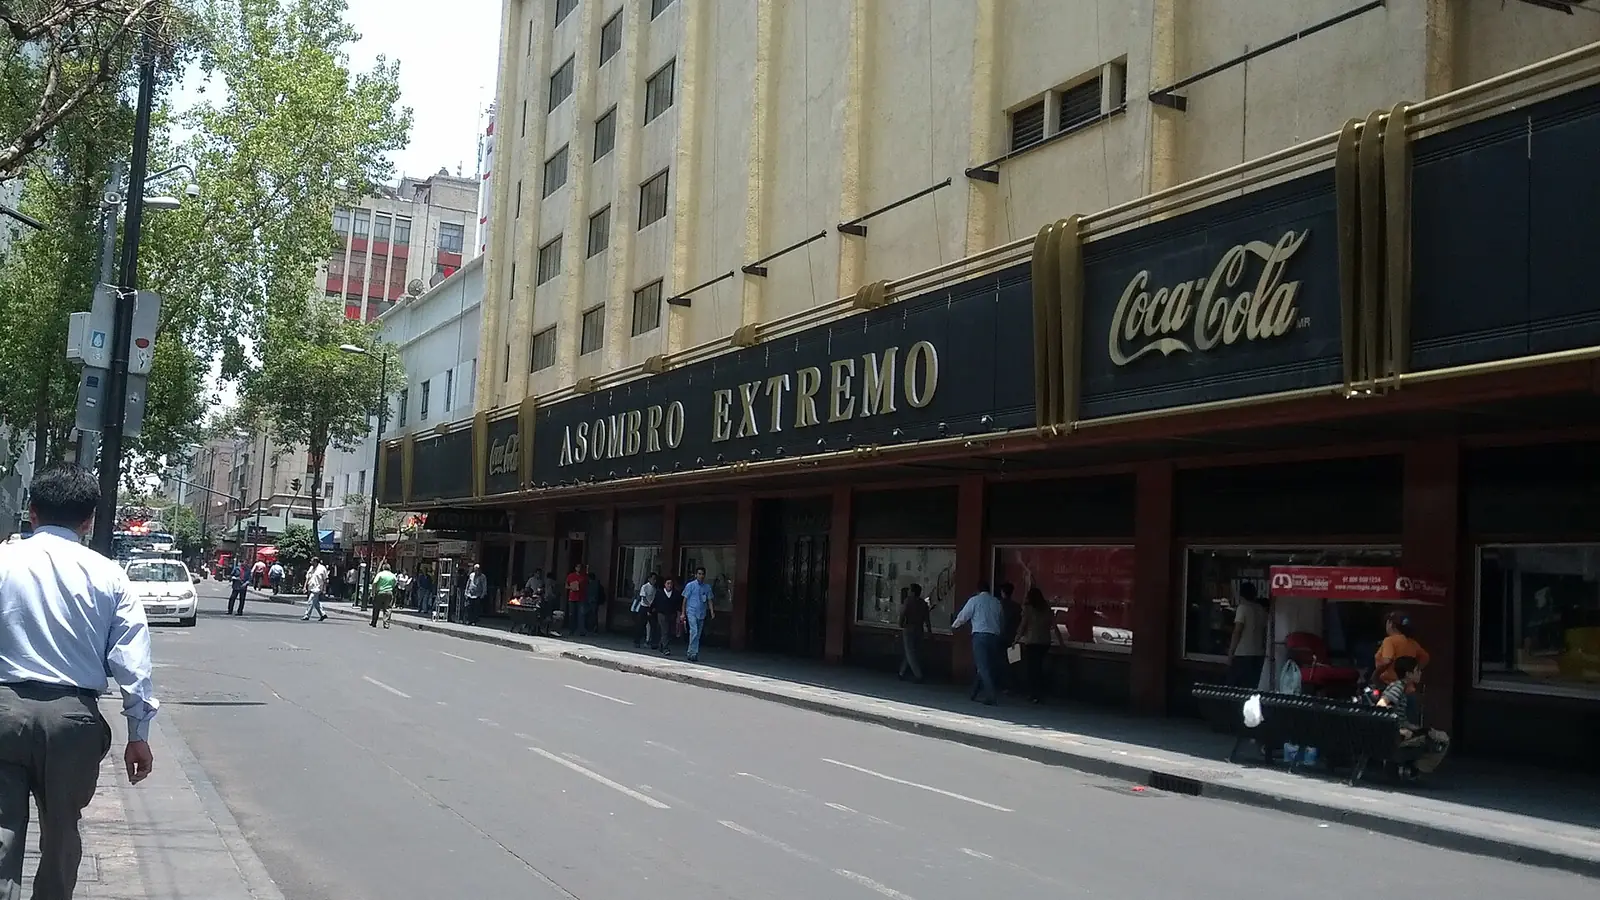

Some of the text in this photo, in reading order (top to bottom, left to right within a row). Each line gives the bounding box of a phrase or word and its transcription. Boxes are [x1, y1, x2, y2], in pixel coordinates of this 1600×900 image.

[1109, 228, 1309, 366] Coca-Cola
[558, 340, 939, 467] ASOMBRO EXTREMO
